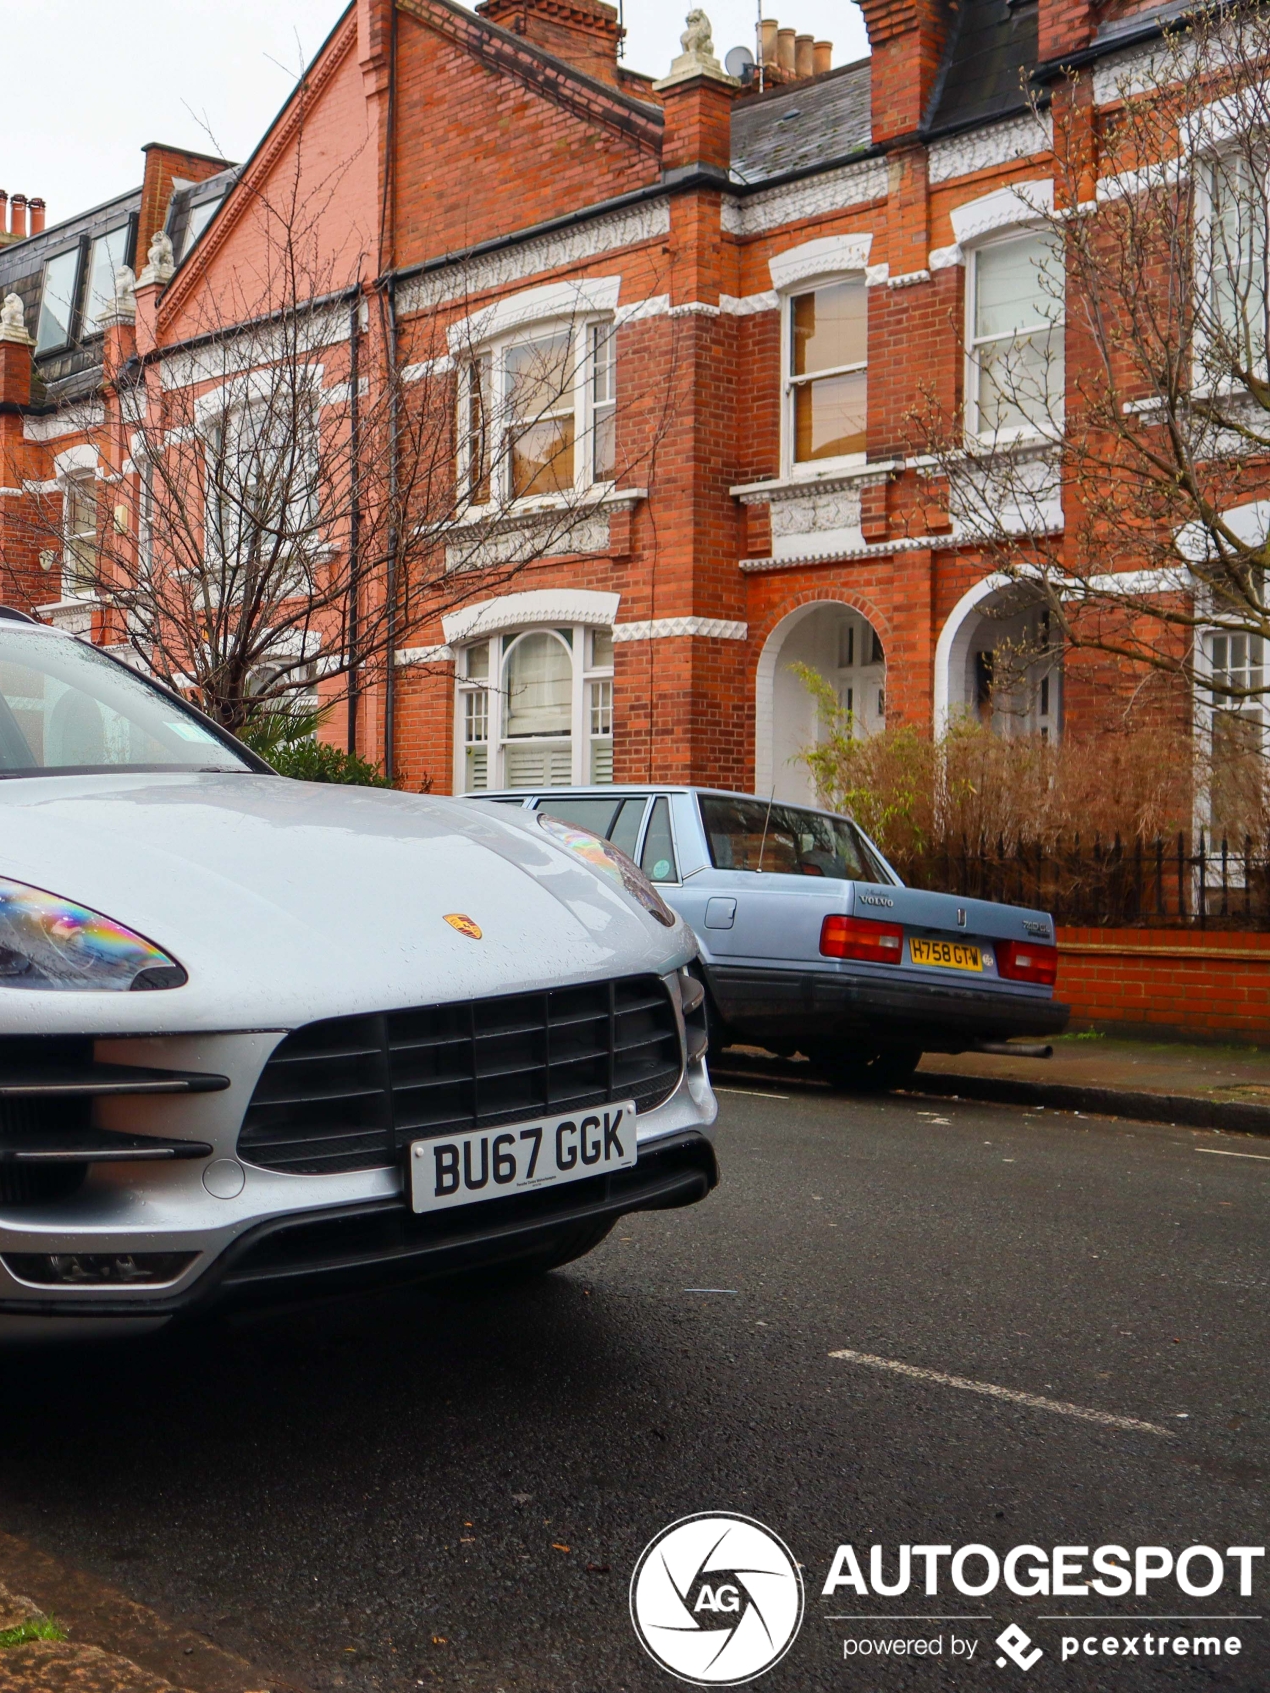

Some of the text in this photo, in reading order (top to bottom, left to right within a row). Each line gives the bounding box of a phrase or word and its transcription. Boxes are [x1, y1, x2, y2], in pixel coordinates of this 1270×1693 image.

[859, 894, 895, 908] VOLVO
[913, 939, 979, 966] H758 GTW
[433, 1109, 625, 1198] BU67 GGK
